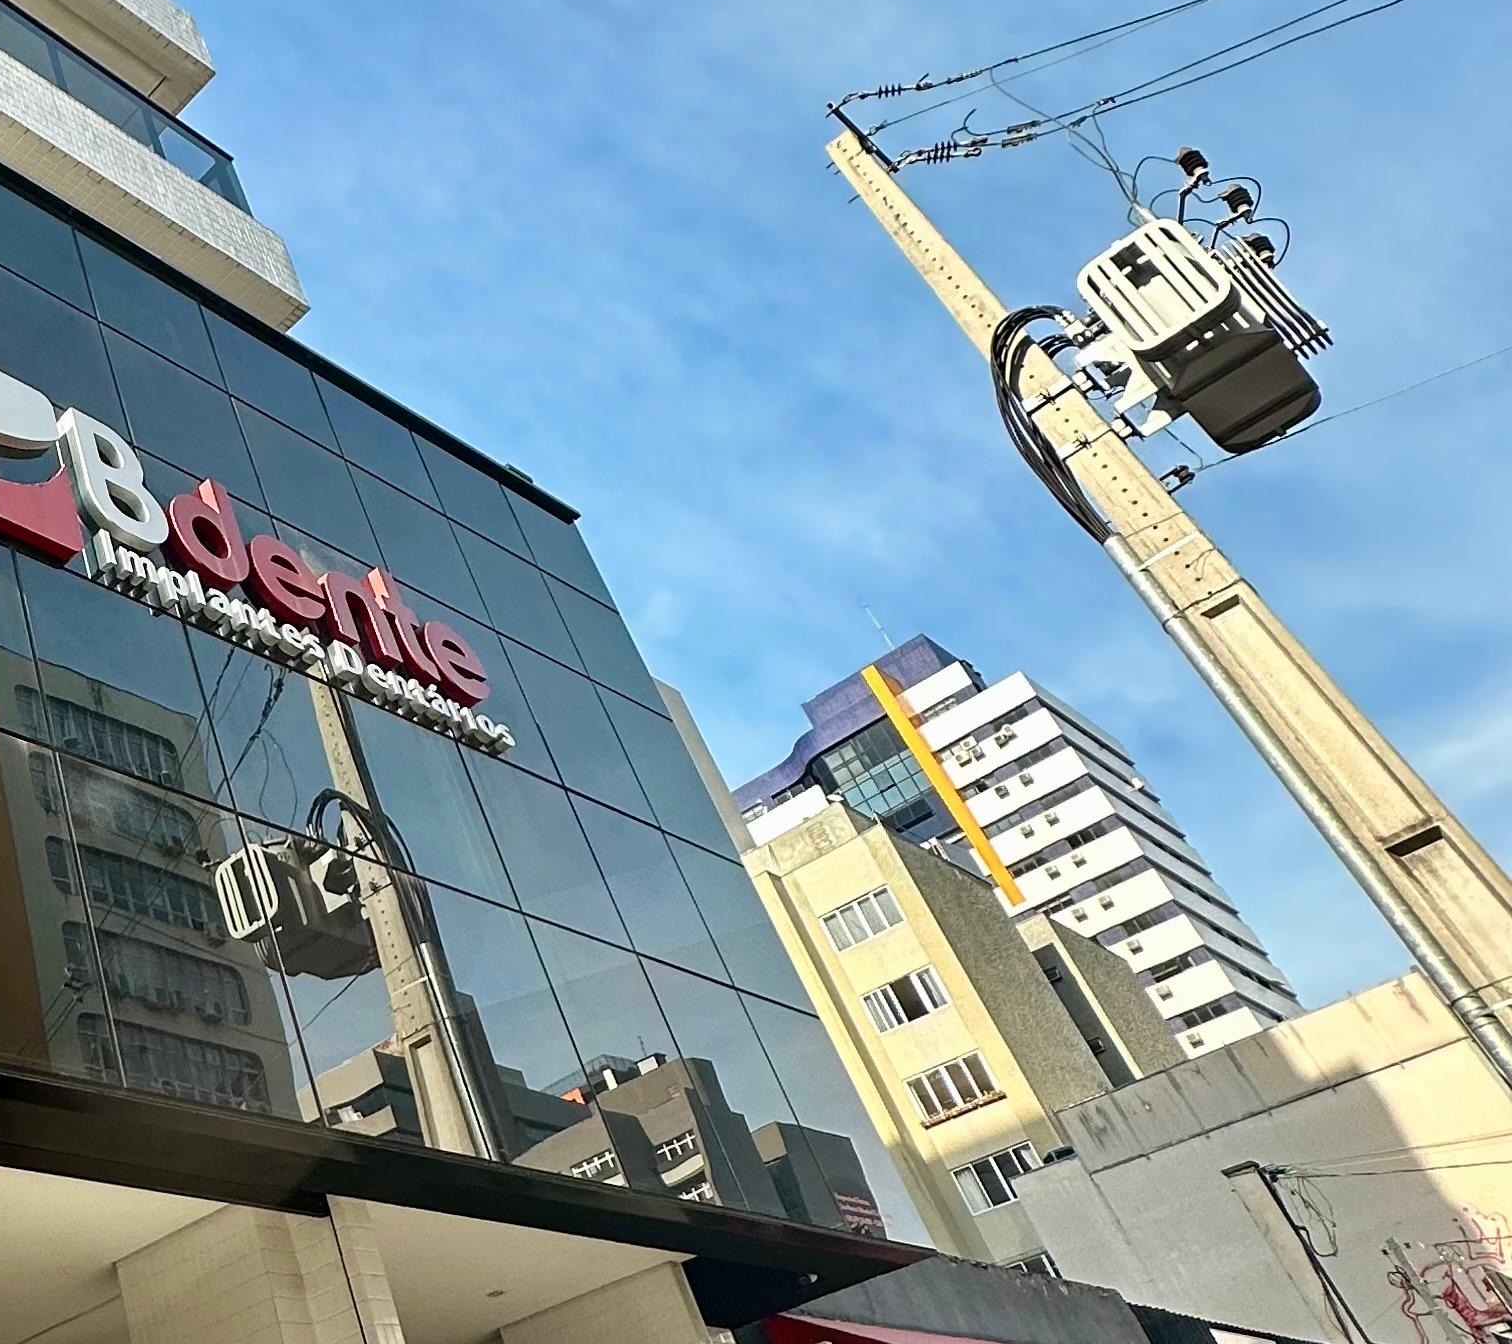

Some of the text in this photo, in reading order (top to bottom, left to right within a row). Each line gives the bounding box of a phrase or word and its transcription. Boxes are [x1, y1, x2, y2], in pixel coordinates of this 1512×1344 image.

[57, 406, 491, 708] Bdente
[91, 528, 518, 755] Implantes Dentários
